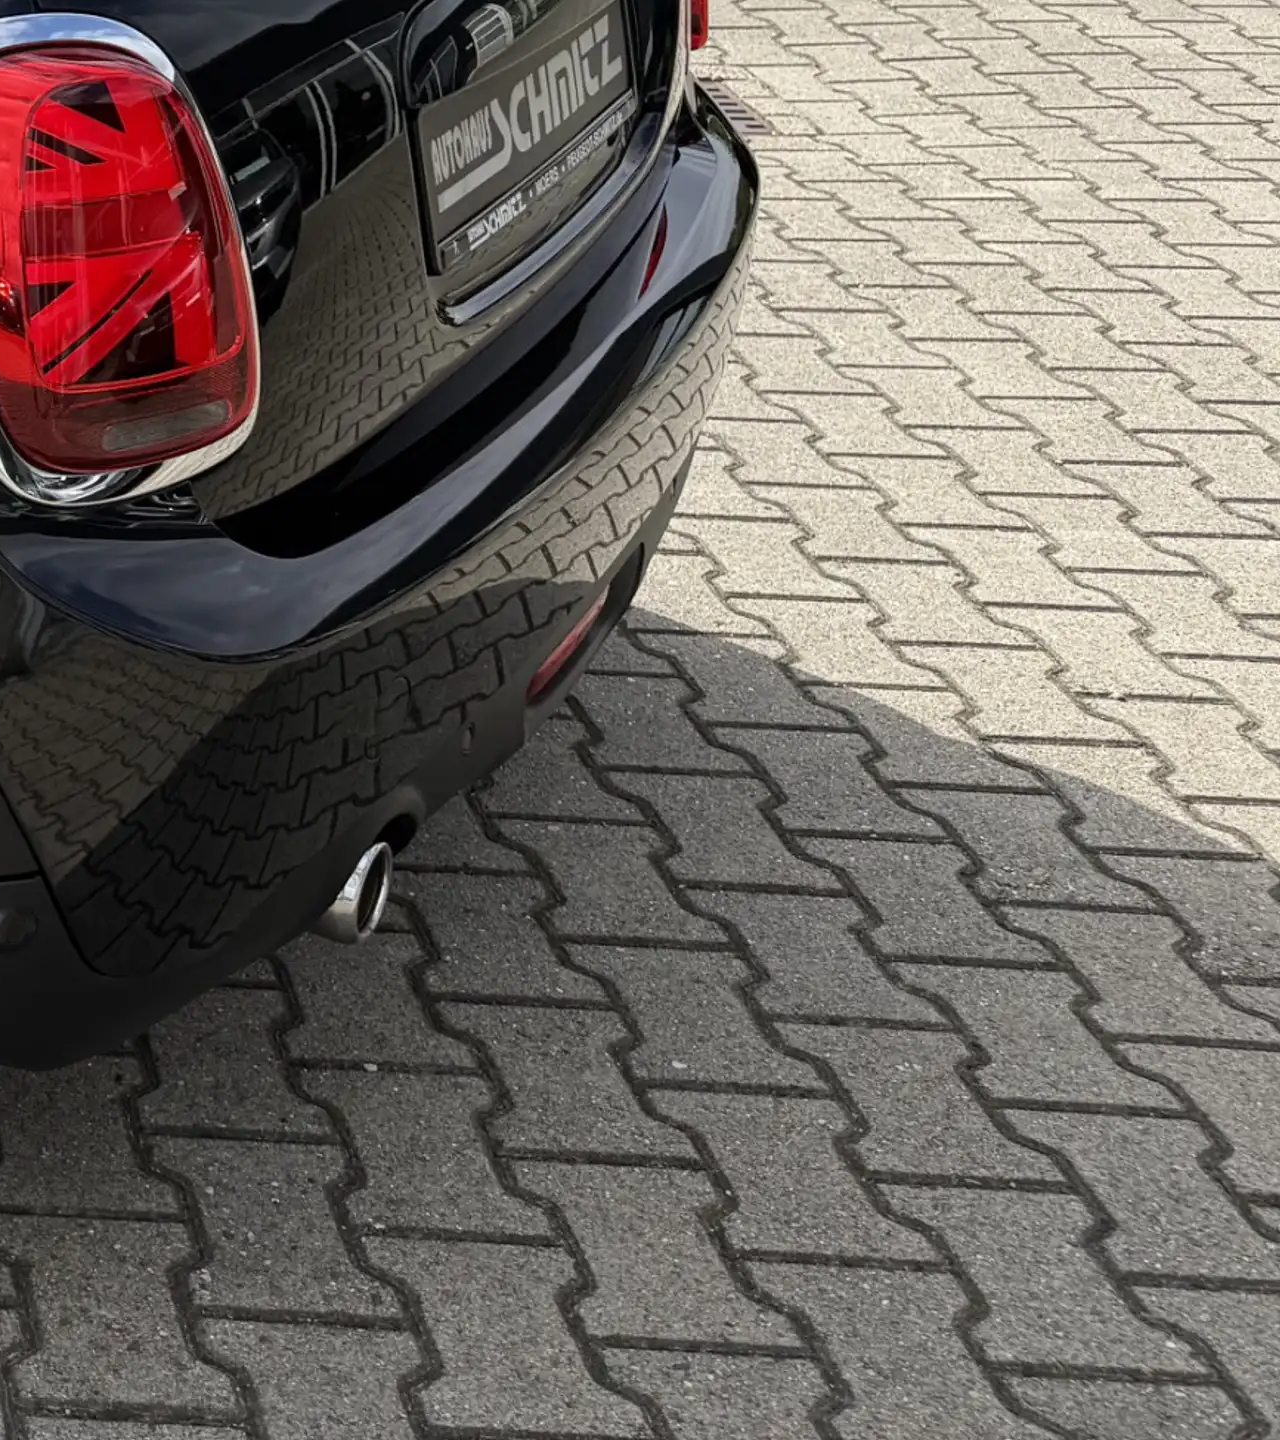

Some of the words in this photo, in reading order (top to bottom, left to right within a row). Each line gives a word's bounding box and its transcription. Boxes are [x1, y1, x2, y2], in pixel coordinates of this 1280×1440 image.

[430, 105, 493, 187] AUTOHAUS
[438, 13, 623, 213] SCHMITZ
[535, 166, 561, 196] MOERS
